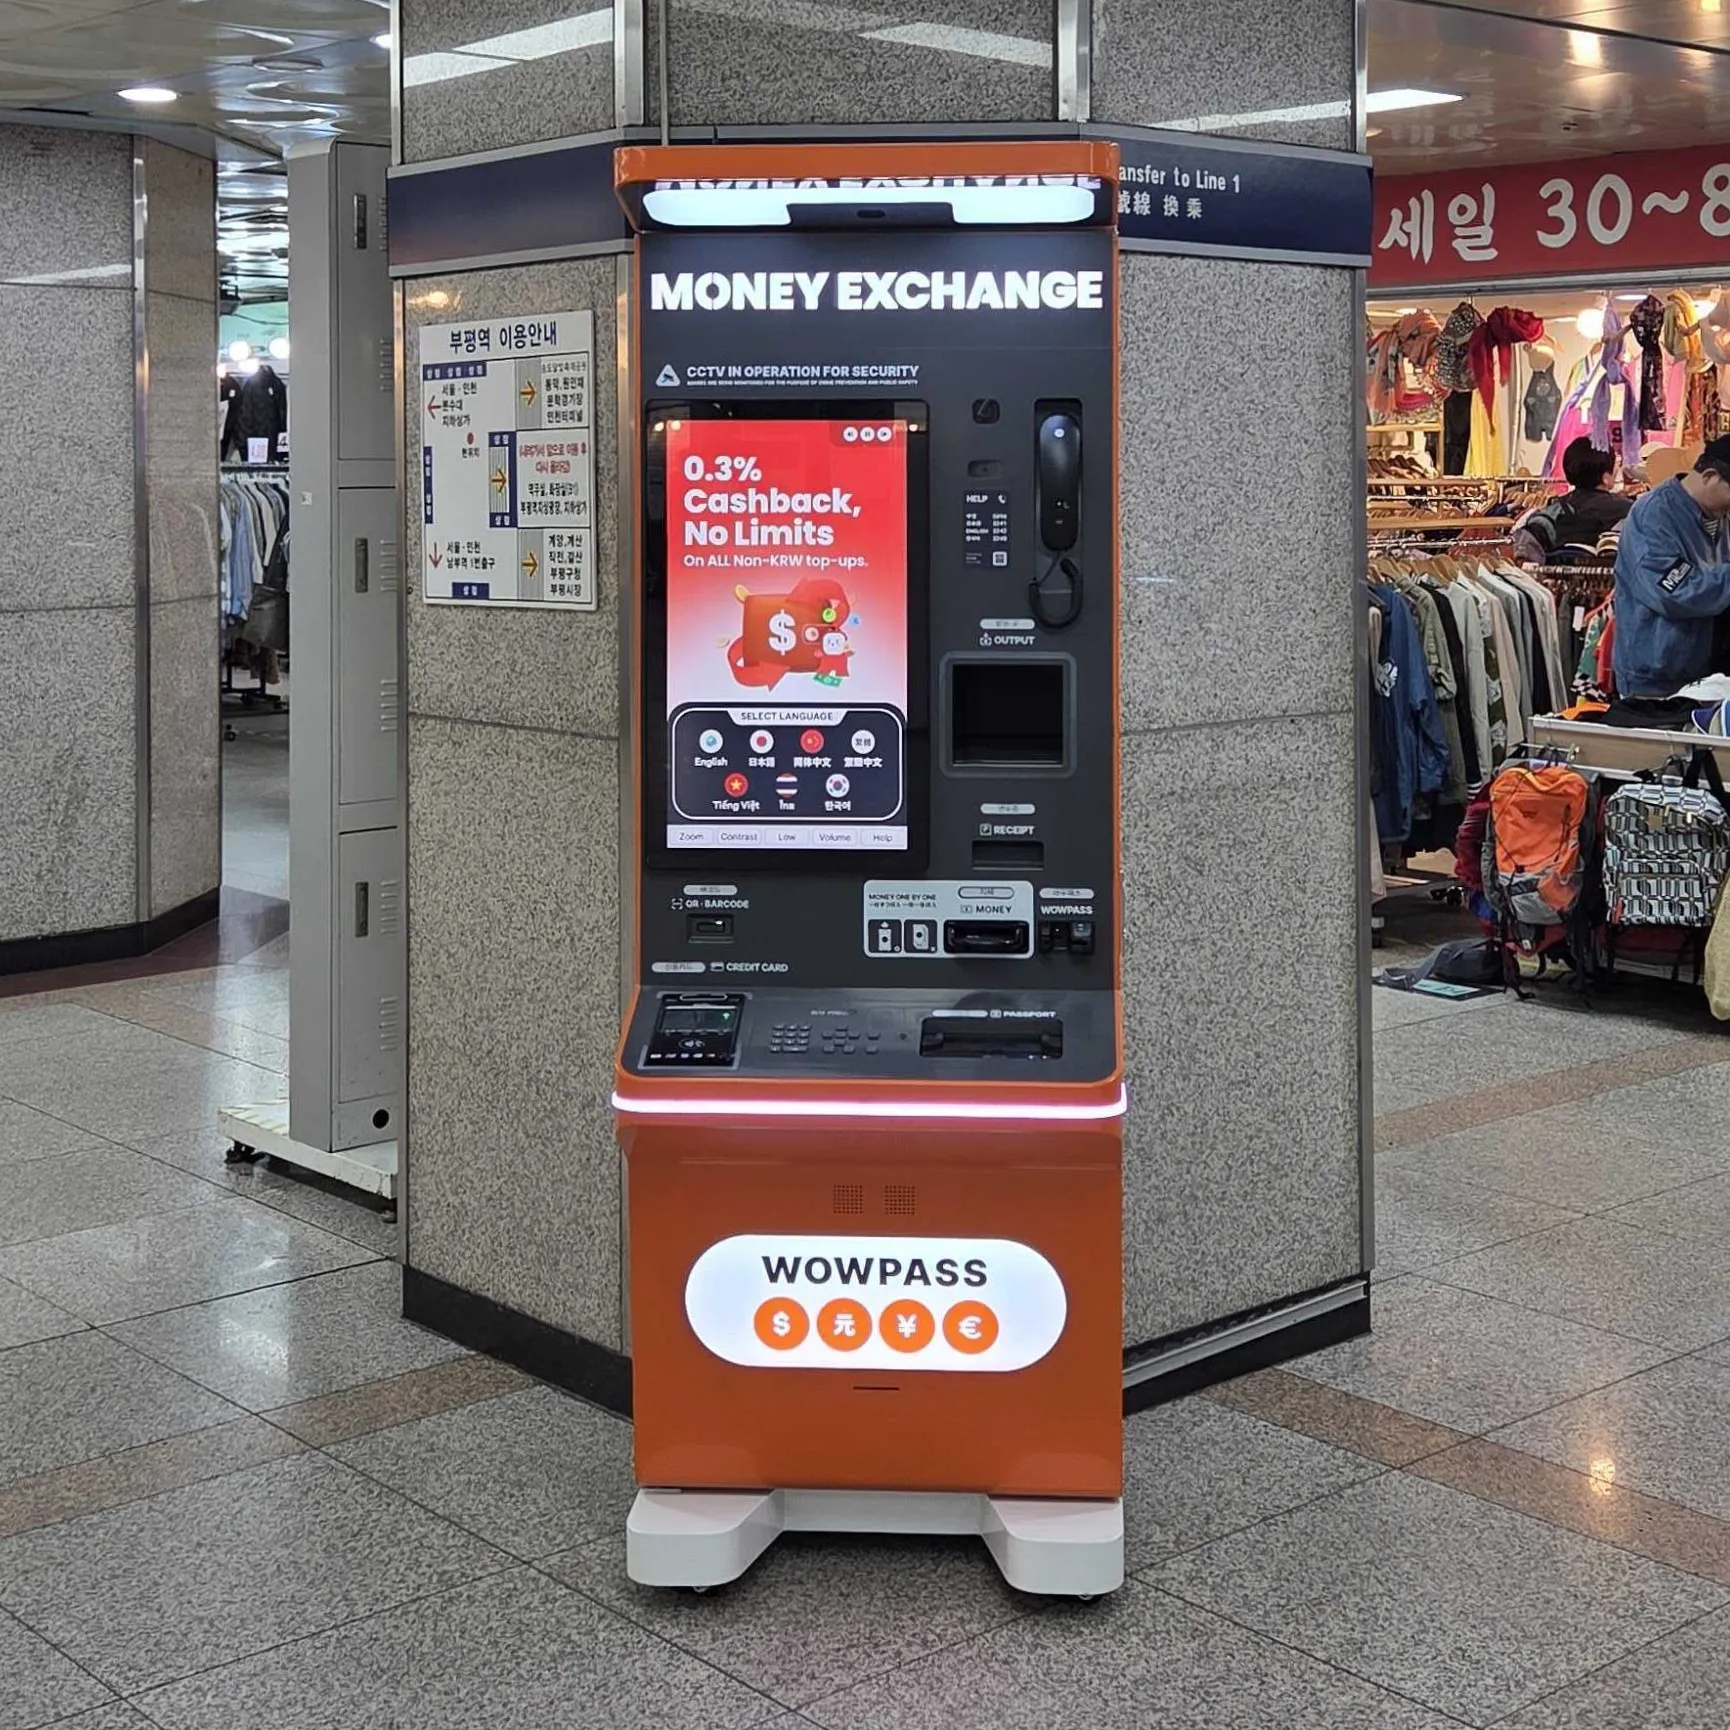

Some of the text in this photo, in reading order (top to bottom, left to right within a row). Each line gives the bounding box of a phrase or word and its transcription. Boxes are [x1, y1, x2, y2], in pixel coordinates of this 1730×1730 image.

[1118, 164, 1166, 185] ansfer
[1173, 166, 1190, 187] to
[1196, 169, 1226, 190] Line
[1232, 174, 1240, 193] 1
[1378, 183, 1498, 265] 세일
[651, 270, 1103, 311] MONEY EXCHANGE
[450, 320, 557, 354] 부평역 이용안내
[687, 365, 919, 377] CCTV IN OPERATION FOR SECURITY
[684, 455, 762, 481] 0.3%
[684, 487, 861, 518] Cashback,
[684, 517, 834, 546] No Limits
[684, 554, 869, 571] On ALL Non-KRW top-ups.
[994, 635, 1036, 645] OUTPUT
[741, 712, 833, 721] SELECT LANGUAGE
[694, 757, 728, 768] English
[993, 825, 1036, 835] RECEIPT
[679, 832, 704, 841] Zoom
[720, 832, 758, 841] Contrast
[778, 833, 796, 841] Low
[819, 833, 851, 842] Volume
[873, 833, 893, 843] Help
[704, 899, 750, 909] BARCODE
[976, 905, 1012, 914] MONEY
[1041, 905, 1094, 915] WOWPASS
[726, 962, 789, 973] CREDIT CARD
[762, 1255, 988, 1287] WOWPASS
[772, 1310, 982, 1339] $ 元 ¥ €
